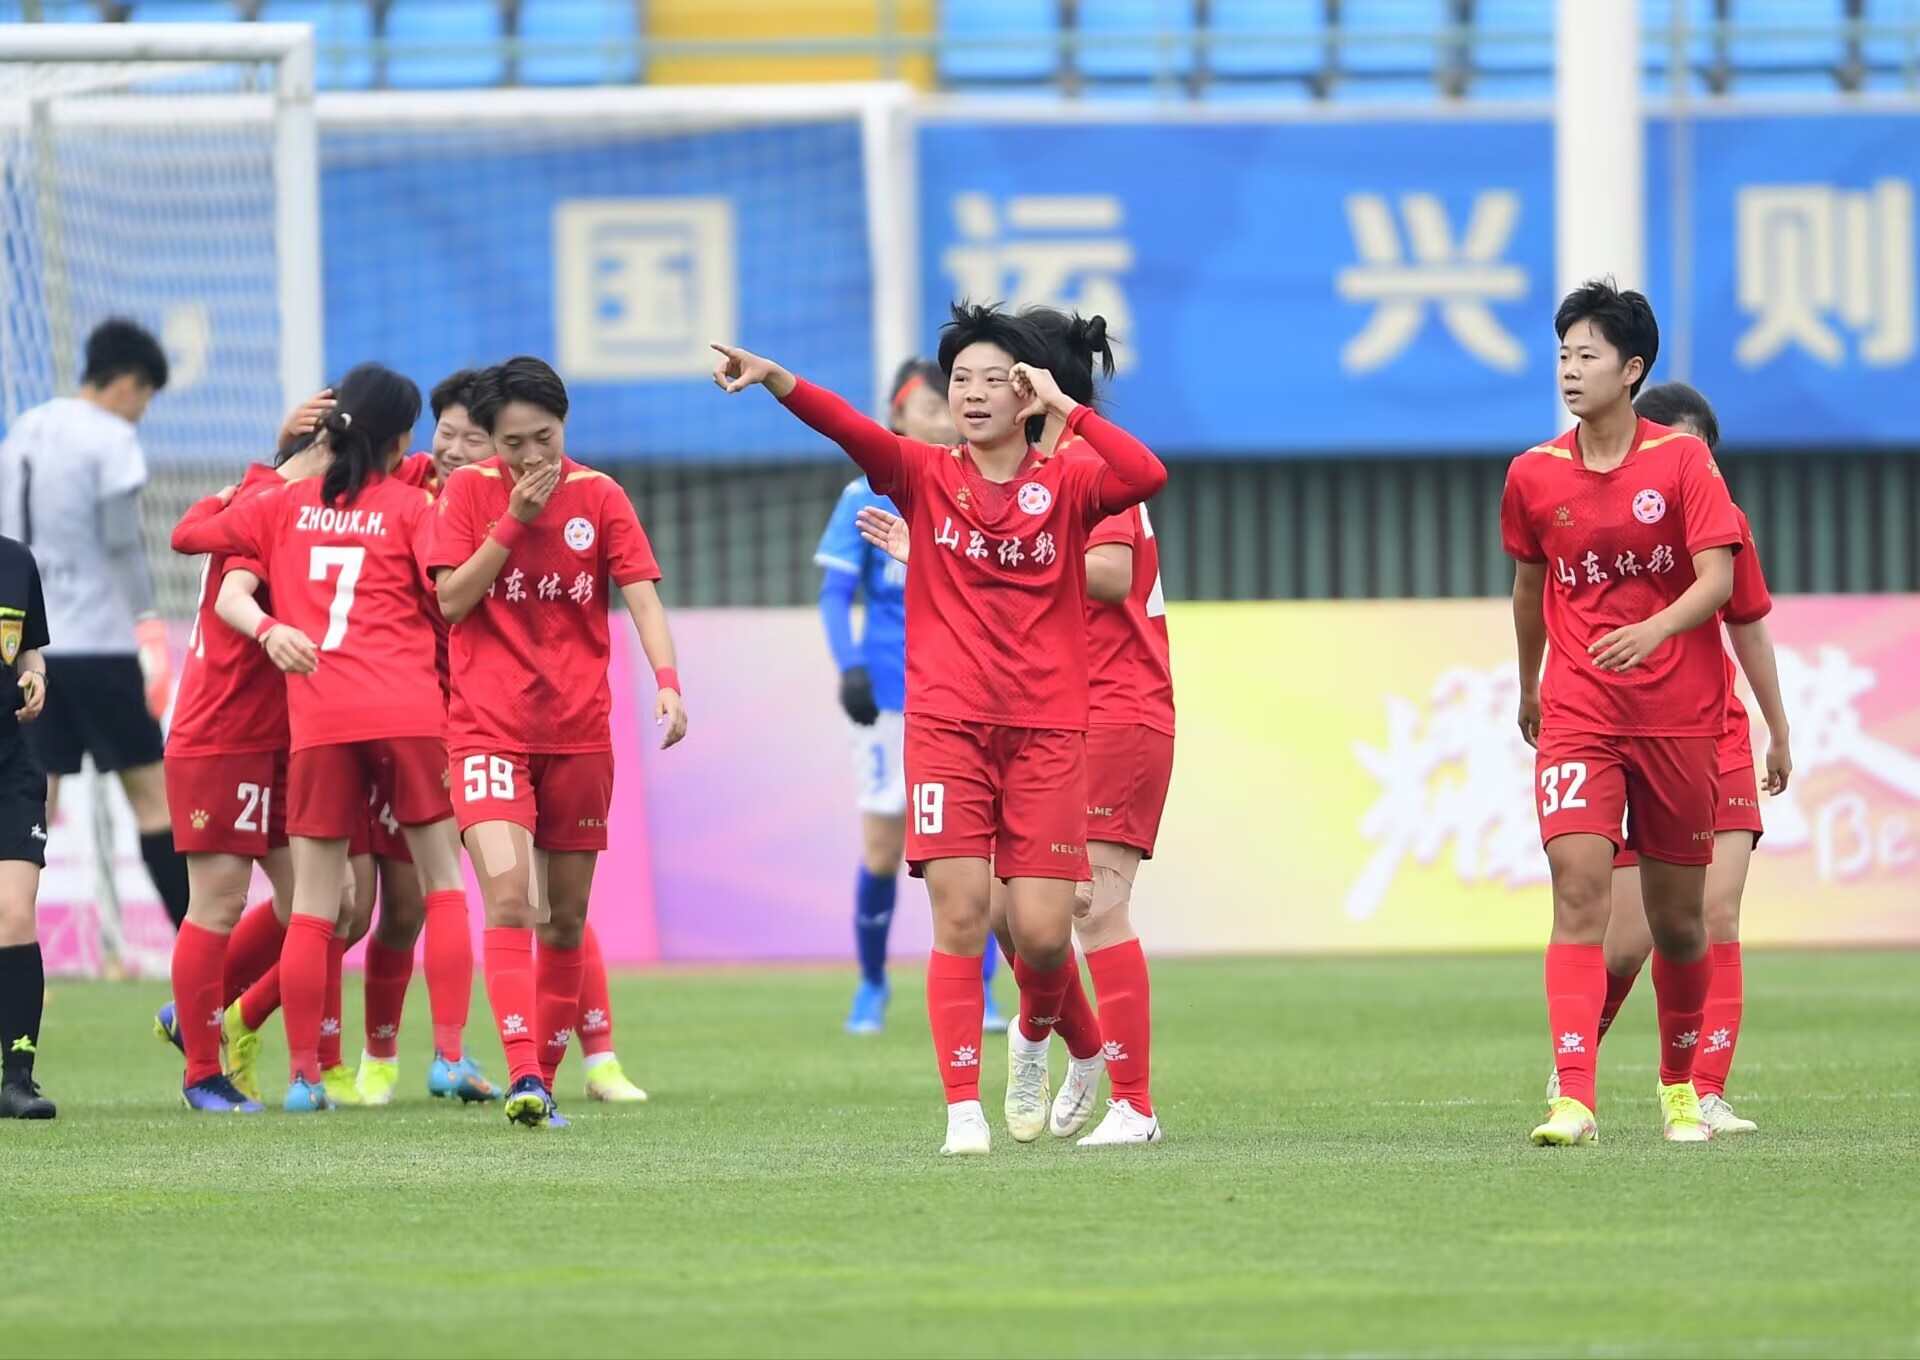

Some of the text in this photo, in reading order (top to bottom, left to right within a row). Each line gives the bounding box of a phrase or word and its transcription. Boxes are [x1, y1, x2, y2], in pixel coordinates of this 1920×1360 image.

[296, 505, 387, 536] ZHOUX.H.
[488, 568, 594, 605] 东体彩
[1554, 544, 1676, 586] 山东体彩
[308, 545, 366, 652] 7
[463, 754, 515, 803] 59
[1540, 762, 1588, 817] 32
[234, 782, 272, 834] 21
[912, 782, 945, 835] 19
[1085, 804, 1113, 817] LME
